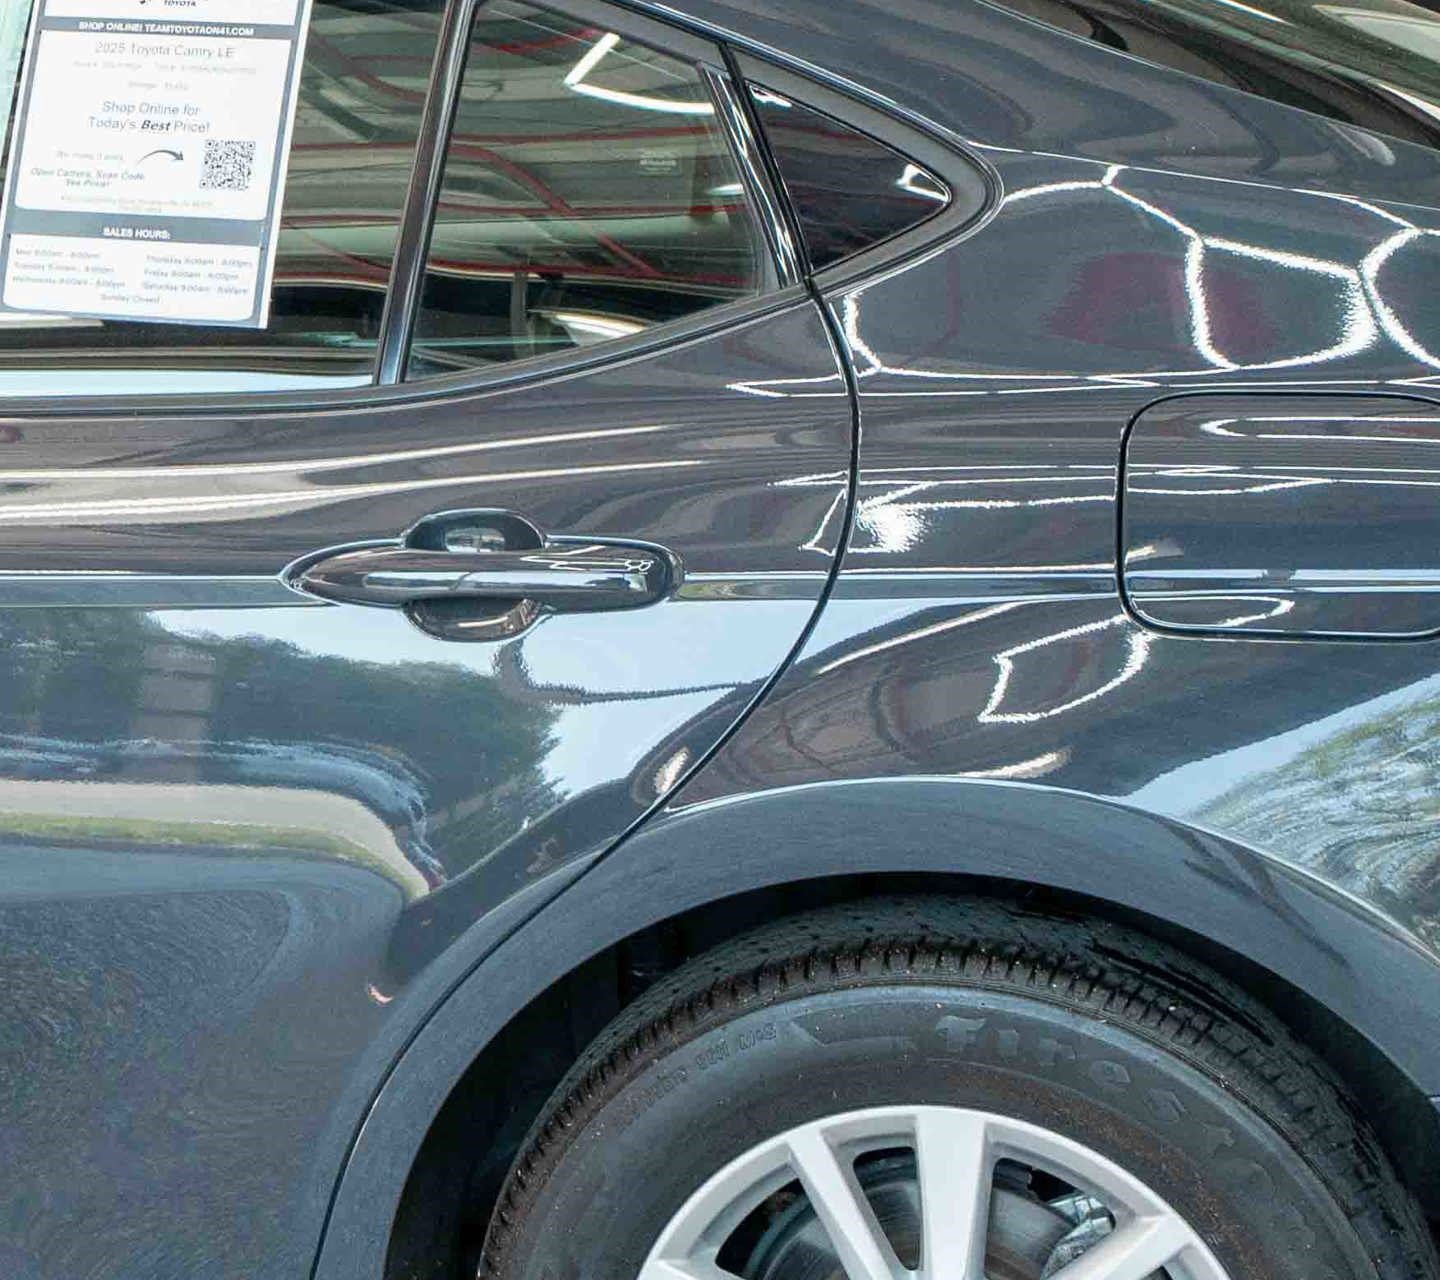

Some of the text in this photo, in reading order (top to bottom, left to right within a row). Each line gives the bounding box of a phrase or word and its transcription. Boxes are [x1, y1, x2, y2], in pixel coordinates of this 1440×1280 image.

[163, 0, 197, 8] TOYOTA
[79, 21, 105, 32] SHOP
[106, 22, 142, 34] ONLINE!
[95, 41, 235, 60] 2025 Toyota Camry LE
[102, 101, 201, 117] Shop Online for
[87, 116, 211, 134] Today's Best Price!
[103, 227, 171, 240] SALES HOURS:
